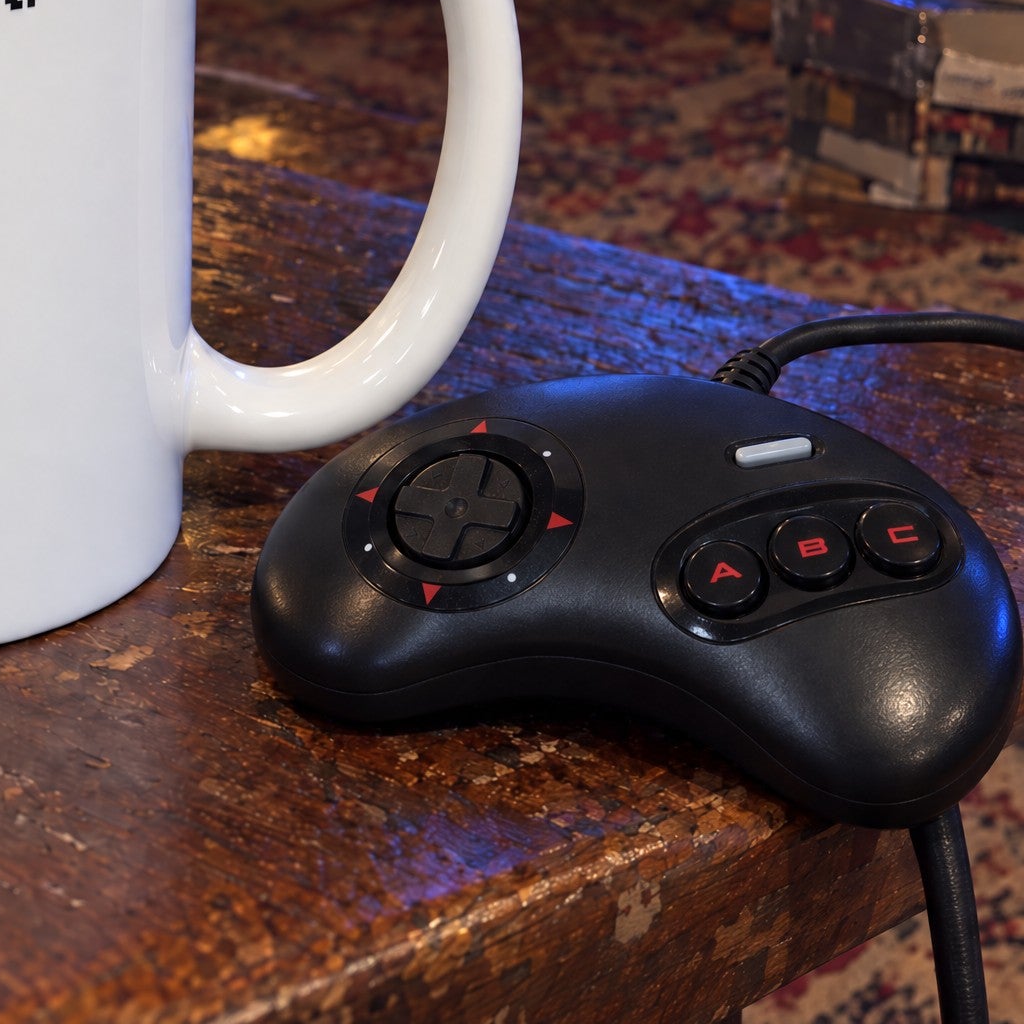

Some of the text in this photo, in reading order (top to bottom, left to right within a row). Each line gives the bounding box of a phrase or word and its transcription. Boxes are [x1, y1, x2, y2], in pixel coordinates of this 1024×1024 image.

[709, 524, 919, 584] A B C
